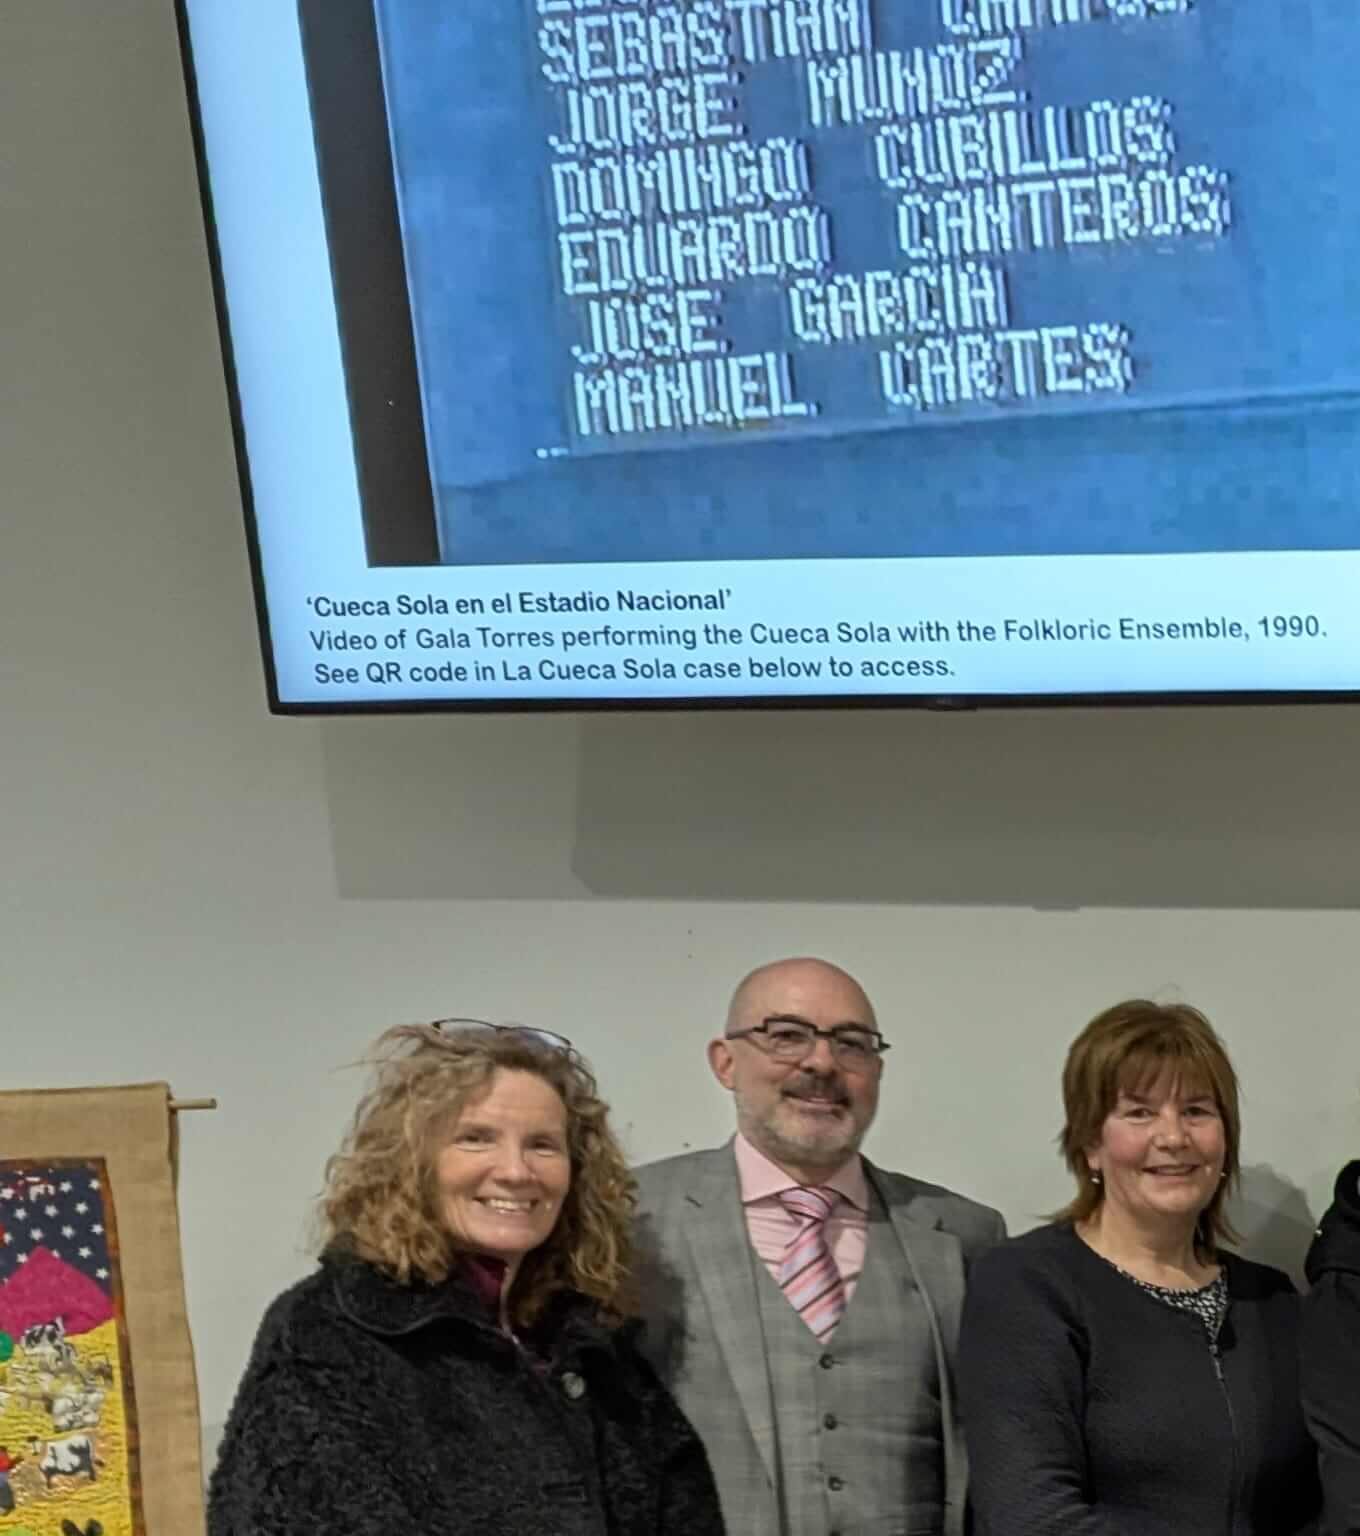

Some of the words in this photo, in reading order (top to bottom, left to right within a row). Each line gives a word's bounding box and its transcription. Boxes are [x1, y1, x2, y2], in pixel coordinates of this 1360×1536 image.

[549, 72, 740, 154] JORGE
[552, 139, 811, 226] DOMINGO
[875, 97, 1176, 189] CUBILLOS
[558, 206, 830, 296] EDUARDO
[897, 166, 1231, 259] CANTEROS
[571, 288, 732, 364] JOSE
[788, 260, 1008, 343] GARCIA
[574, 350, 818, 436] MANUEL
[879, 323, 1136, 409] CARTES
[309, 629, 378, 651] Video
[384, 628, 407, 650] of
[415, 627, 472, 649] Gala
[476, 626, 556, 648] Torres
[561, 624, 697, 652] performing
[703, 623, 744, 645] the
[750, 622, 830, 645] Cueca
[836, 621, 891, 644] Sola
[899, 620, 950, 643] with
[956, 619, 997, 641] the
[1004, 618, 1111, 642] Folkloric
[1119, 617, 1250, 642] Ensemble,
[1257, 615, 1328, 639] 1990.
[396, 593, 449, 615] Sola
[455, 599, 485, 614] en
[491, 592, 512, 613] el
[518, 591, 611, 613] Estadio
[314, 662, 360, 684] See
[365, 661, 402, 685] QR
[408, 660, 469, 683] code
[473, 660, 497, 682] in
[501, 659, 533, 682] La
[538, 658, 618, 681] Cueca
[622, 657, 677, 680] Sola
[682, 659, 743, 680] case
[749, 656, 823, 679] below
[828, 655, 853, 678] to
[860, 658, 956, 679] access.
